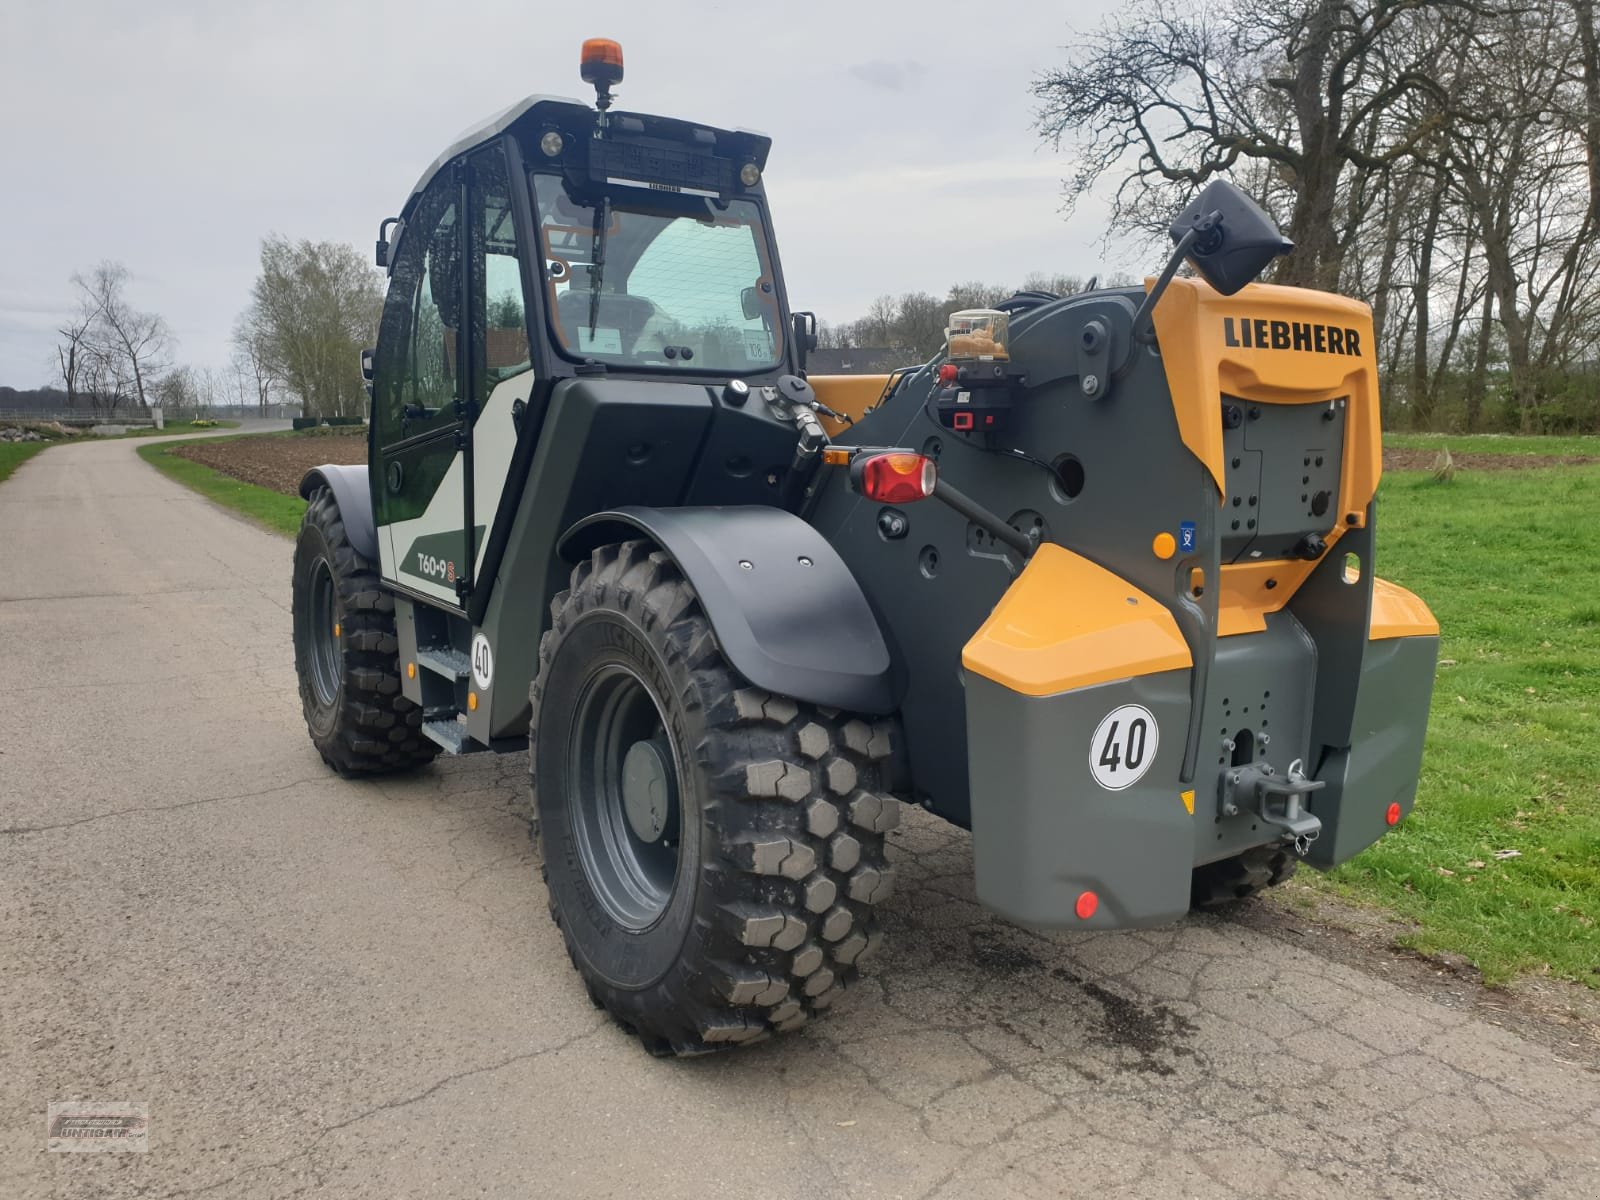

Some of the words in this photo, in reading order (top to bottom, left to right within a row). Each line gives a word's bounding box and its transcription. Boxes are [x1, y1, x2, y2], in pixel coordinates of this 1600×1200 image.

[1224, 317, 1362, 357] LIEBHERR
[475, 641, 489, 679] 40
[1099, 718, 1147, 773] 40
